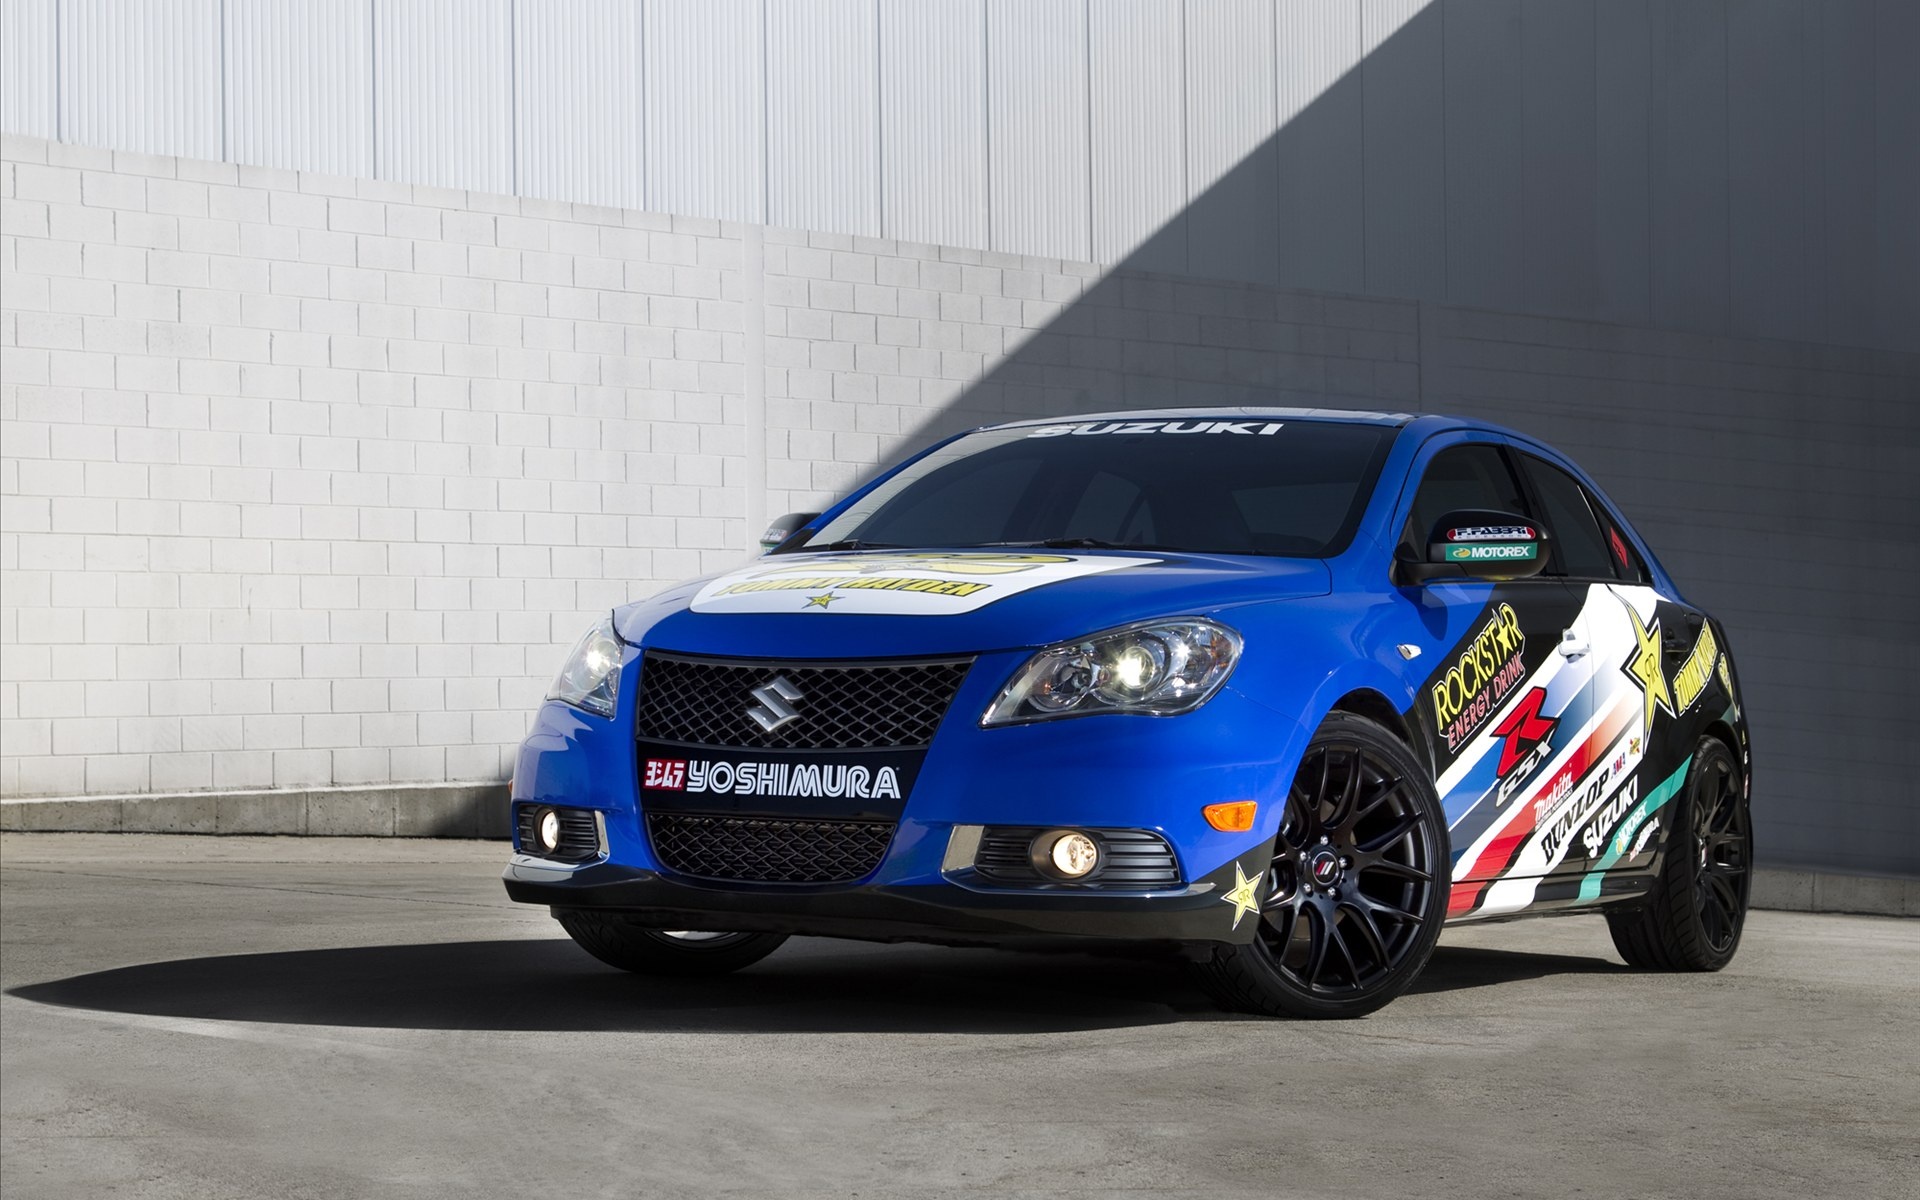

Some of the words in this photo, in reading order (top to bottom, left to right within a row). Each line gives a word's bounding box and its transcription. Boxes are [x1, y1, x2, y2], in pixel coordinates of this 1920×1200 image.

[1027, 421, 1284, 438] SUZUKI
[1471, 546, 1530, 558] MOTOREX
[711, 577, 846, 597] TOMMY
[835, 577, 993, 597] HAYDEN
[1448, 686, 1490, 748] ENERGY
[1493, 651, 1524, 700] DRINK
[686, 760, 901, 799] YOSHIMURA
[1541, 767, 1610, 866] DUNLOP
[1583, 774, 1639, 859] SUZUKI
